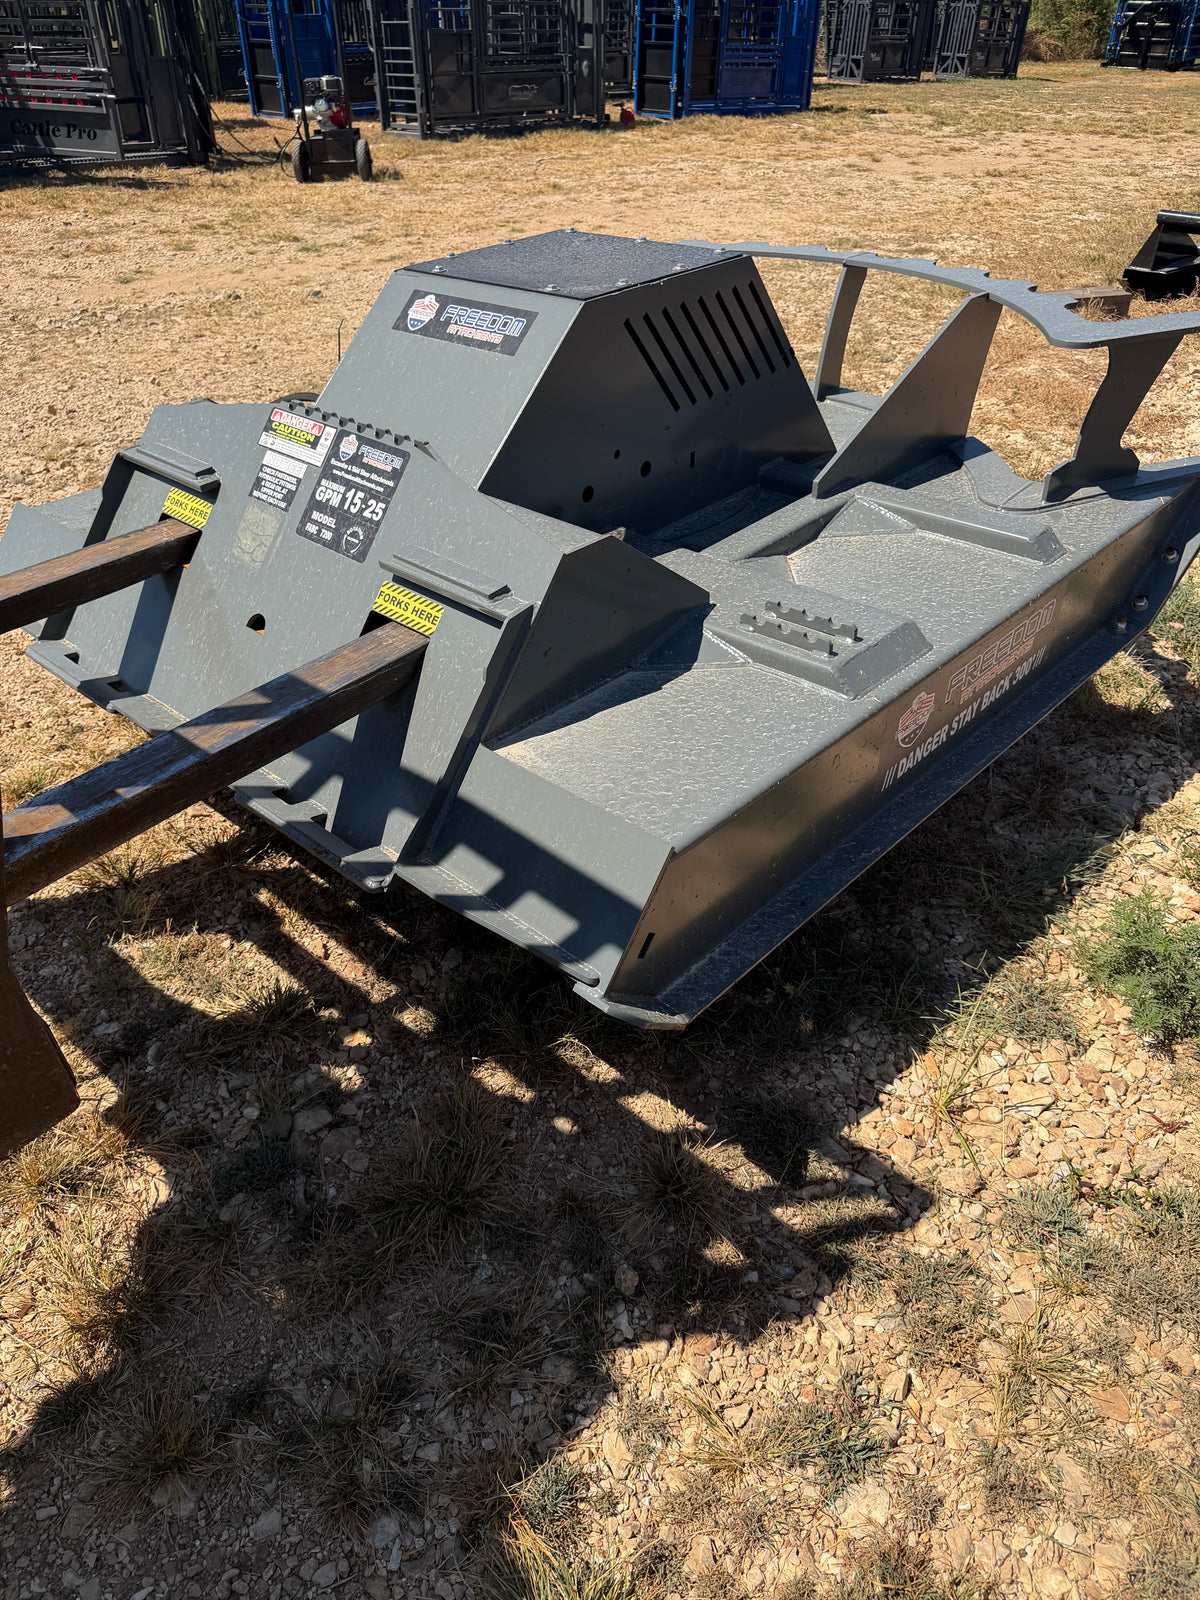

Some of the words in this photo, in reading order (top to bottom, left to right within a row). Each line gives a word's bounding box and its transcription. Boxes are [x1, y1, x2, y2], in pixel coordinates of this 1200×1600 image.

[10, 118, 61, 138] Cattle
[66, 123, 97, 140] Pro
[440, 305, 526, 337] FREEDOM
[272, 421, 315, 442] CAUTION
[279, 413, 314, 432] DANGER
[358, 444, 403, 469] FREEDOM
[315, 484, 343, 507] GPM
[321, 478, 346, 492] MAXIMUM
[166, 495, 188, 511] FORKS
[189, 506, 209, 521] HERE
[311, 511, 336, 528] MODEL
[378, 590, 410, 612] FORKS
[411, 606, 440, 626] HERE
[945, 599, 1056, 704] FREEDOM
[960, 637, 1034, 704] ATTACHMENTS
[897, 724, 949, 779] DANGER
[950, 702, 982, 736] STAY
[980, 674, 1014, 711] BACK
